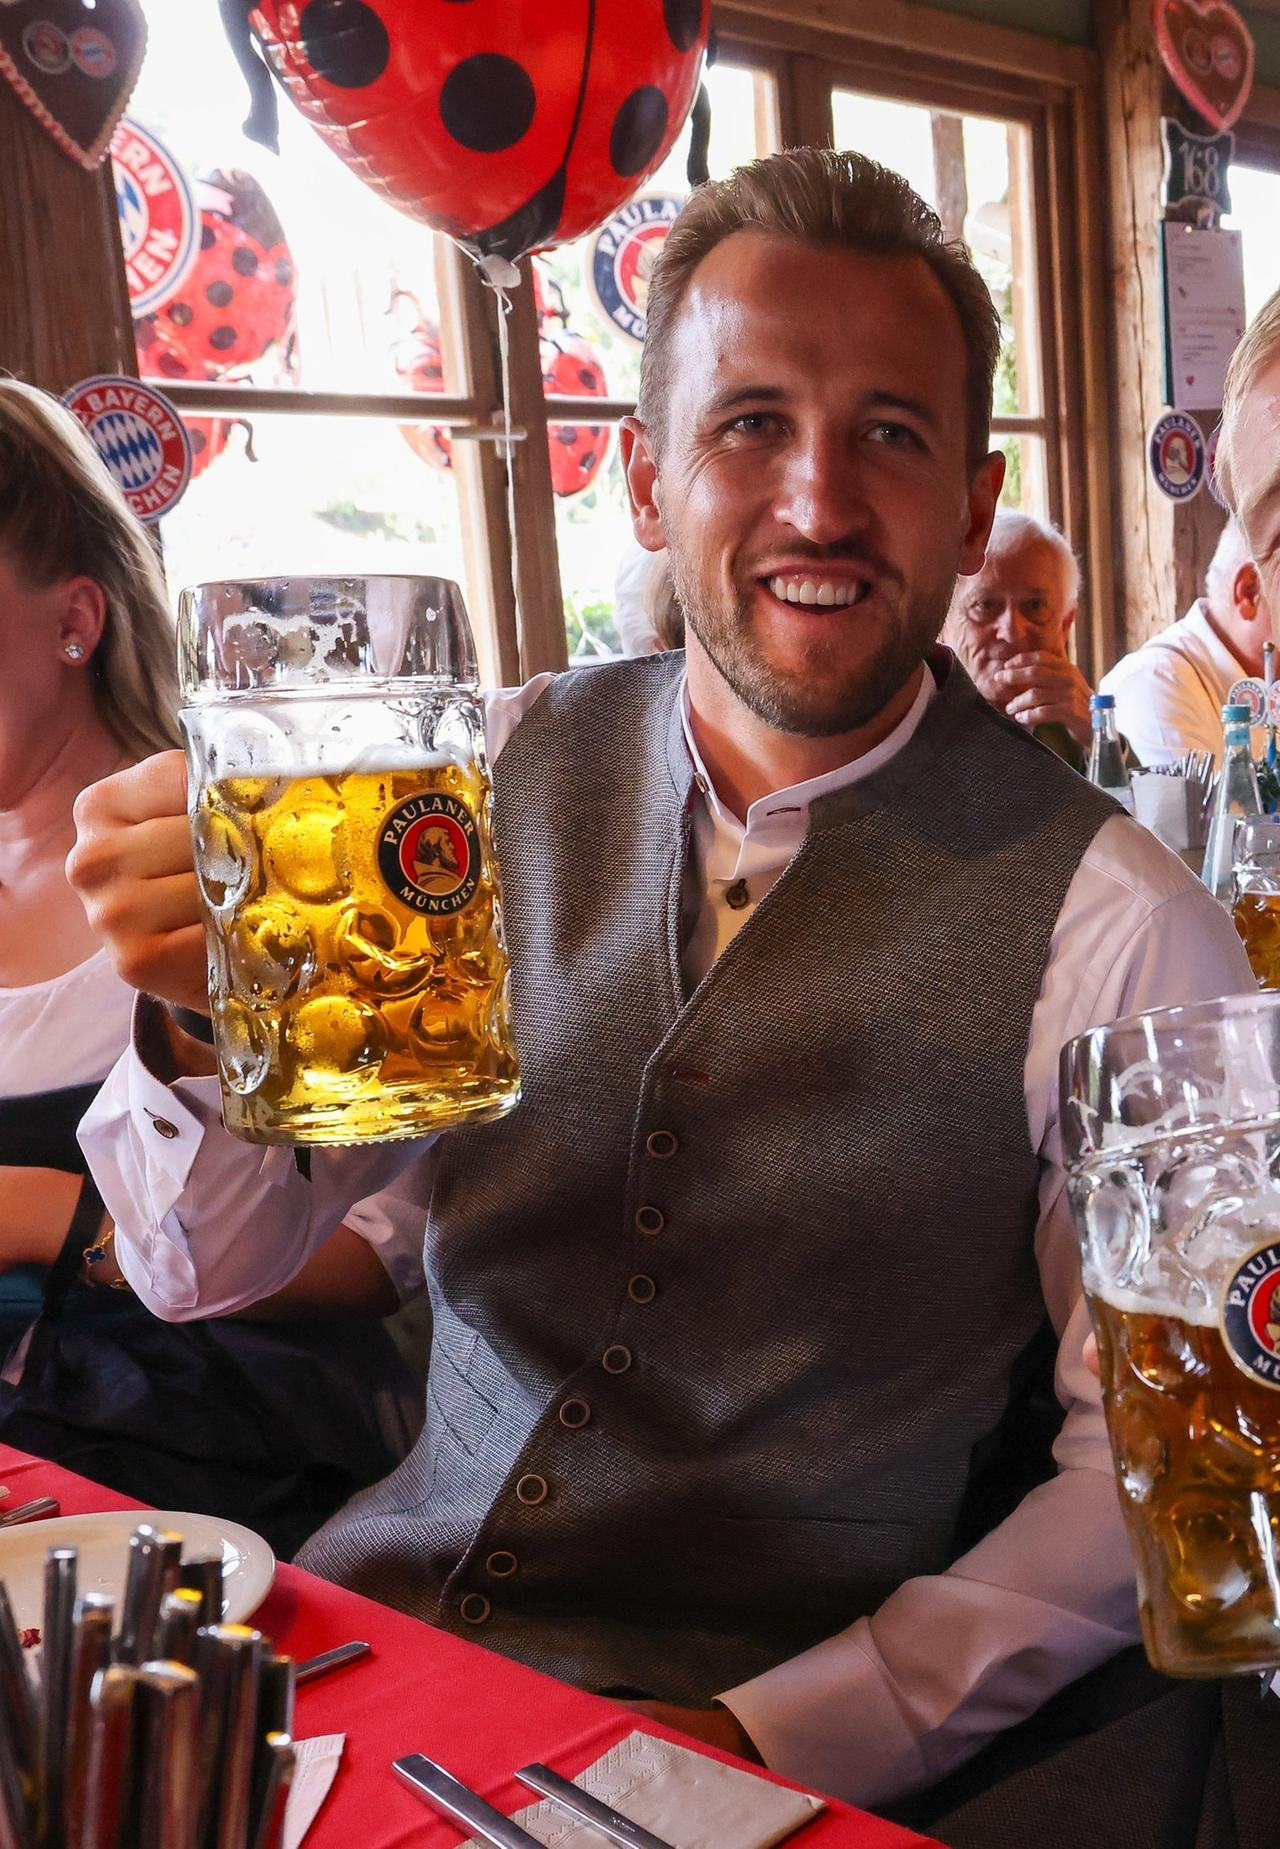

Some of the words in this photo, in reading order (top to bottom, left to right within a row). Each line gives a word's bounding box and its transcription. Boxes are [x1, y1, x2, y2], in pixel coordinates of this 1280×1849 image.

[1178, 141, 1219, 195] 168
[597, 199, 679, 258] PAULA
[86, 389, 178, 441] BAYERN
[126, 463, 182, 515] CHEN
[383, 797, 475, 845] PAULANER
[399, 878, 475, 911] MÜNCHEN
